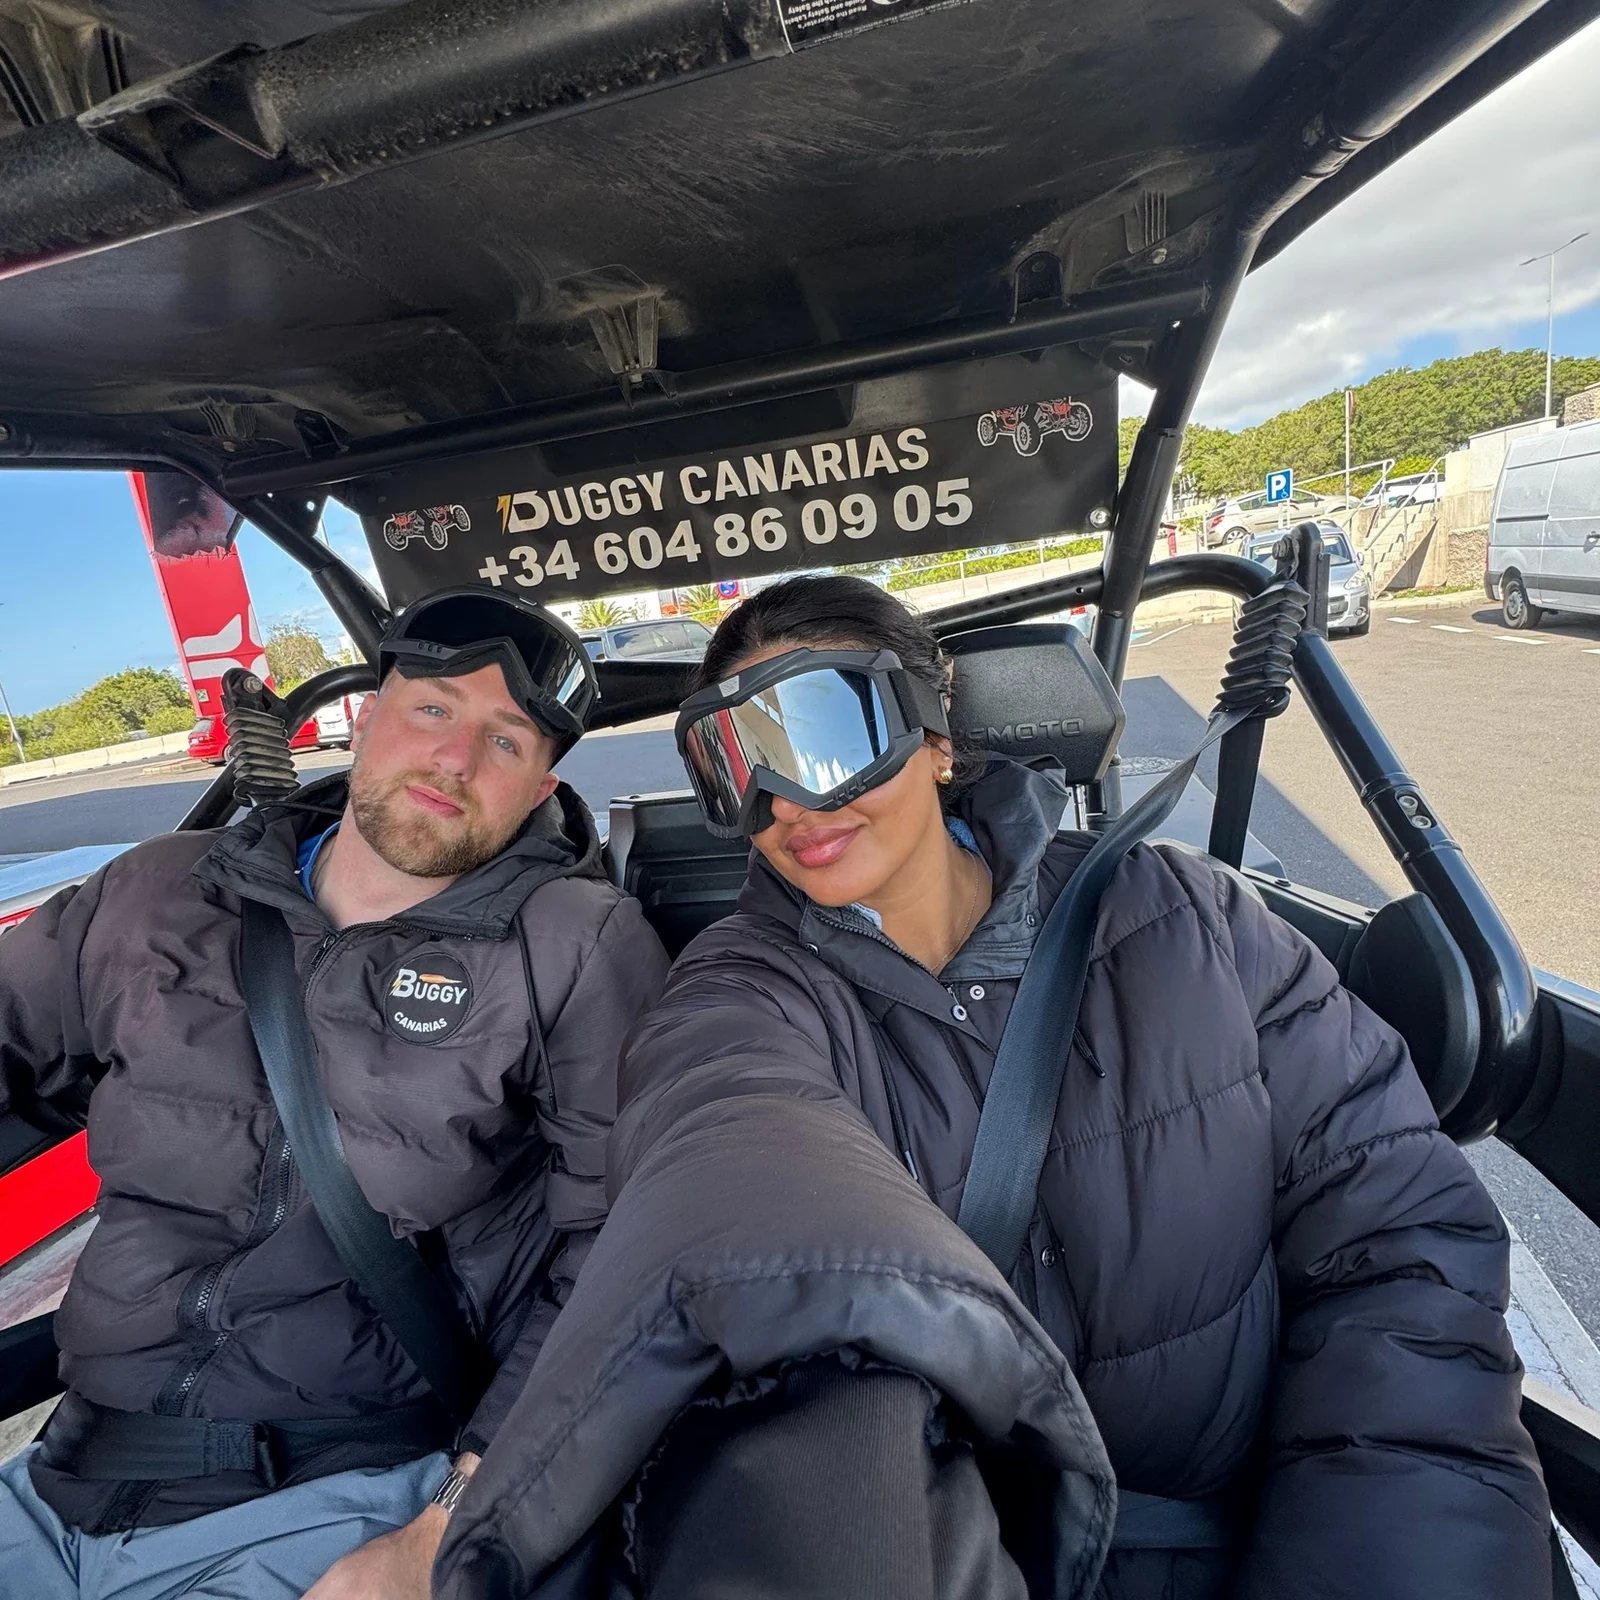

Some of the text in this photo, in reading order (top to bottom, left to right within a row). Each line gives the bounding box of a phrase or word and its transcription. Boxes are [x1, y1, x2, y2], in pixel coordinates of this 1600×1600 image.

[787, 3, 811, 15] Safety
[807, 7, 830, 19] Safety
[811, 0, 824, 8] the
[830, 3, 844, 12] and
[784, 14, 807, 26] Labels
[797, 4, 867, 30] Read the Operator's
[679, 427, 930, 506] CANARIAS
[1271, 474, 1287, 499] P
[478, 477, 974, 588] +34 604 86 09 05
[389, 968, 468, 1005] BUGGY
[394, 1011, 448, 1033] CANARIAS
